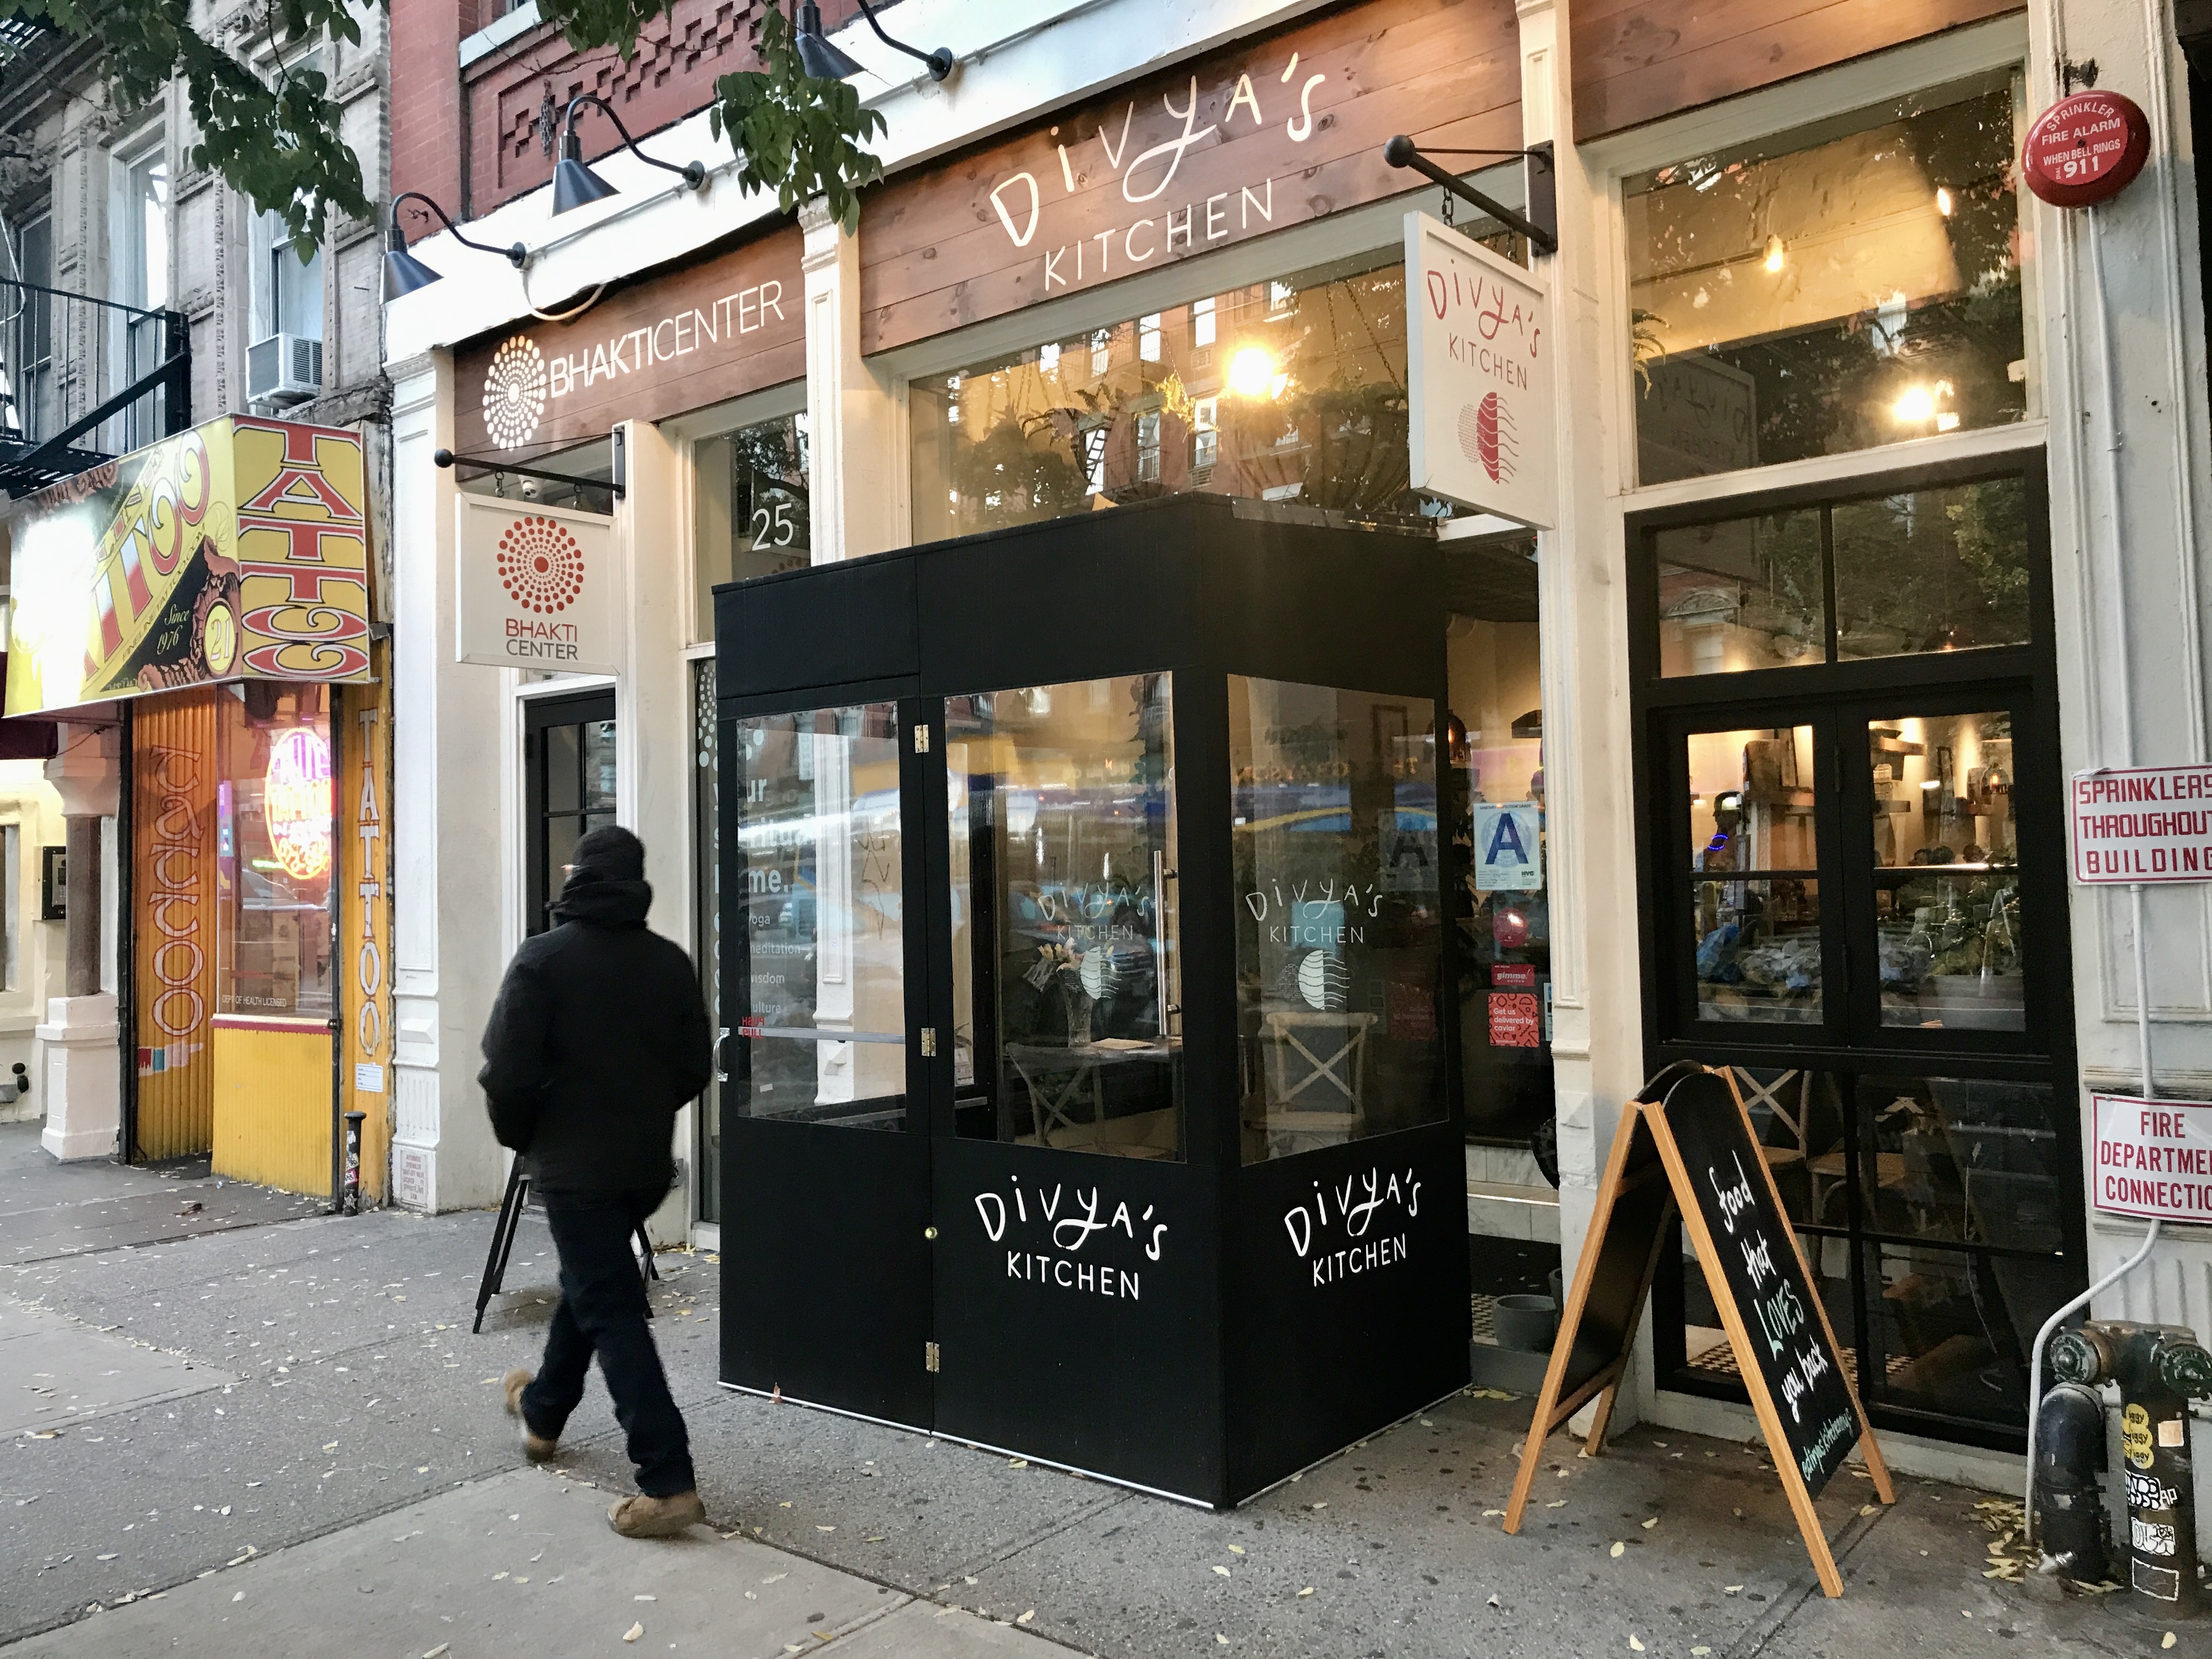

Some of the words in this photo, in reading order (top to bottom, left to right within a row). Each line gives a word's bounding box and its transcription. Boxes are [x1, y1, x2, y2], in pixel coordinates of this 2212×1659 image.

[2042, 131, 2069, 145] FIRE
[2073, 117, 2120, 139] ALARM
[2047, 101, 2115, 131] SPRINKLER
[2043, 151, 2070, 166] WHEN
[2071, 146, 2092, 160] BELL
[2093, 138, 2121, 153] RINGS
[2064, 156, 2099, 178] 911
[1045, 178, 1272, 291] KITCHEN
[550, 280, 785, 399] BHAKTICENTER
[1449, 332, 1527, 391] KITCHEN
[752, 503, 793, 551] 25
[164, 603, 190, 626] Since
[156, 624, 183, 655] 1976
[210, 617, 231, 662] 21
[506, 618, 578, 643] BHAKTI
[506, 639, 579, 661] CENTER
[2079, 774, 2212, 804] SPRINKLERS
[1485, 812, 1529, 865] A
[2086, 847, 2212, 874] BUILDING
[358, 708, 380, 1057] TATTOO
[1057, 924, 1133, 940] KITCHEN
[1269, 926, 1364, 944] KITCHEN
[1497, 969, 1530, 980] gimme!
[222, 995, 234, 1003] DEPT
[235, 996, 242, 1004] OF
[244, 996, 262, 1006] HEALTH
[262, 997, 287, 1007] LICENSED
[751, 1001, 781, 1013] ulture
[1525, 1017, 1534, 1026] by
[2141, 1111, 2186, 1138] FIRE
[2101, 1141, 2212, 1175] DEPARTME
[1708, 1149, 1756, 1234] food
[1312, 1233, 1408, 1288] KITCHEN
[1740, 1229, 1776, 1290] that
[1005, 1249, 1141, 1301] KITCHEN
[1753, 1278, 1804, 1361] LOVES
[1781, 1367, 1805, 1424] you
[1795, 1334, 1828, 1392] back
[2131, 1430, 2148, 1445] iggy
[2133, 1449, 2149, 1464] iggy
